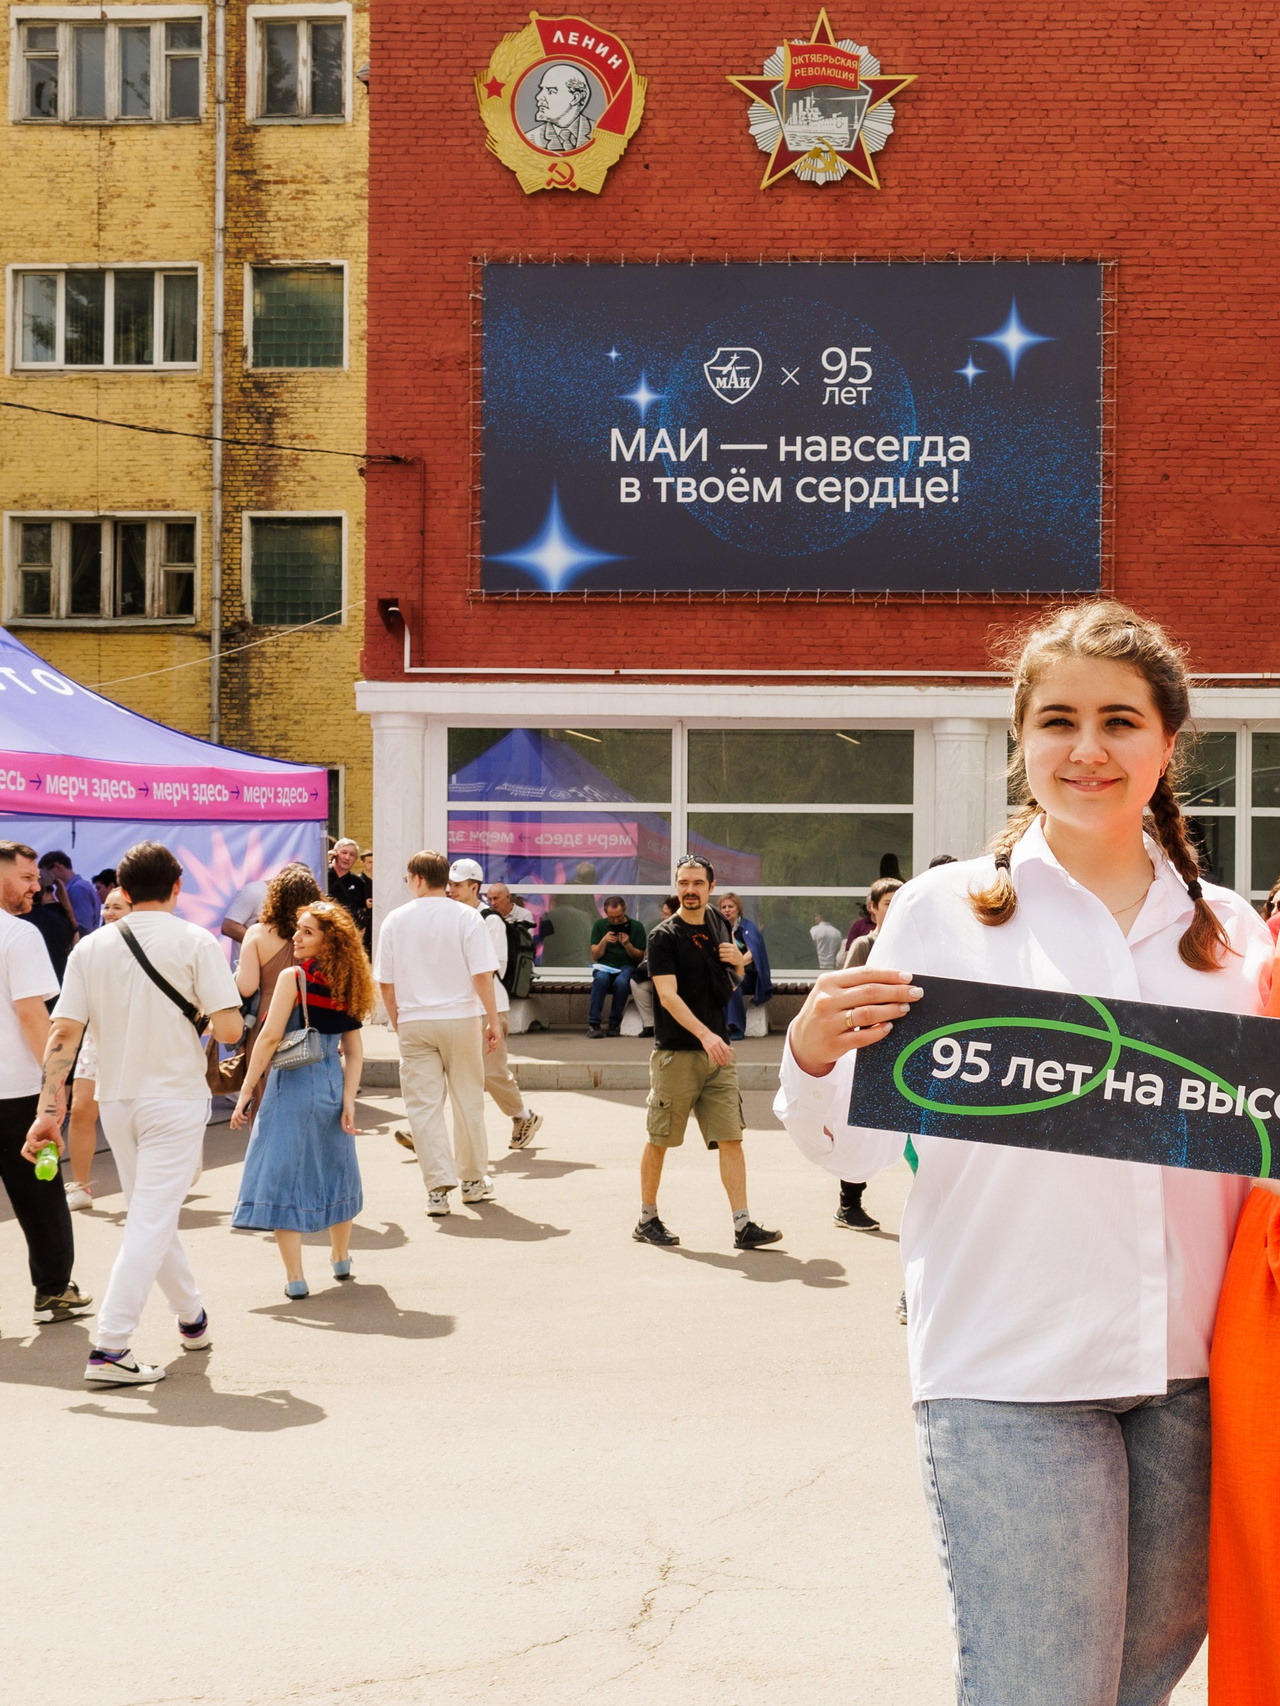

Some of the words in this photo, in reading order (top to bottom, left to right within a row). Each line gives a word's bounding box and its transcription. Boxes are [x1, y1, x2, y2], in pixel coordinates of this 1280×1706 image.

[552, 30, 623, 70] ЛЕНИН
[792, 54, 858, 70] ОКТЯБРЬСКАЯ
[795, 67, 855, 82] РЕВОЛЮЦИЯ
[715, 367, 751, 389] МАИ
[821, 346, 873, 384] 95
[821, 386, 873, 405] лет
[610, 427, 709, 462] МАИ
[779, 435, 972, 467] навсегда
[620, 477, 642, 503] в
[652, 468, 782, 503] твоём
[795, 468, 961, 513] сердце!
[46, 774, 88, 803] мерч
[91, 778, 137, 802] здесь
[152, 782, 189, 807] мерч
[192, 783, 230, 805] здесь
[243, 786, 274, 809] мерч
[276, 786, 309, 807] здесь
[931, 1037, 992, 1083] 95
[1001, 1056, 1093, 1096] лет
[1103, 1069, 1164, 1107] на
